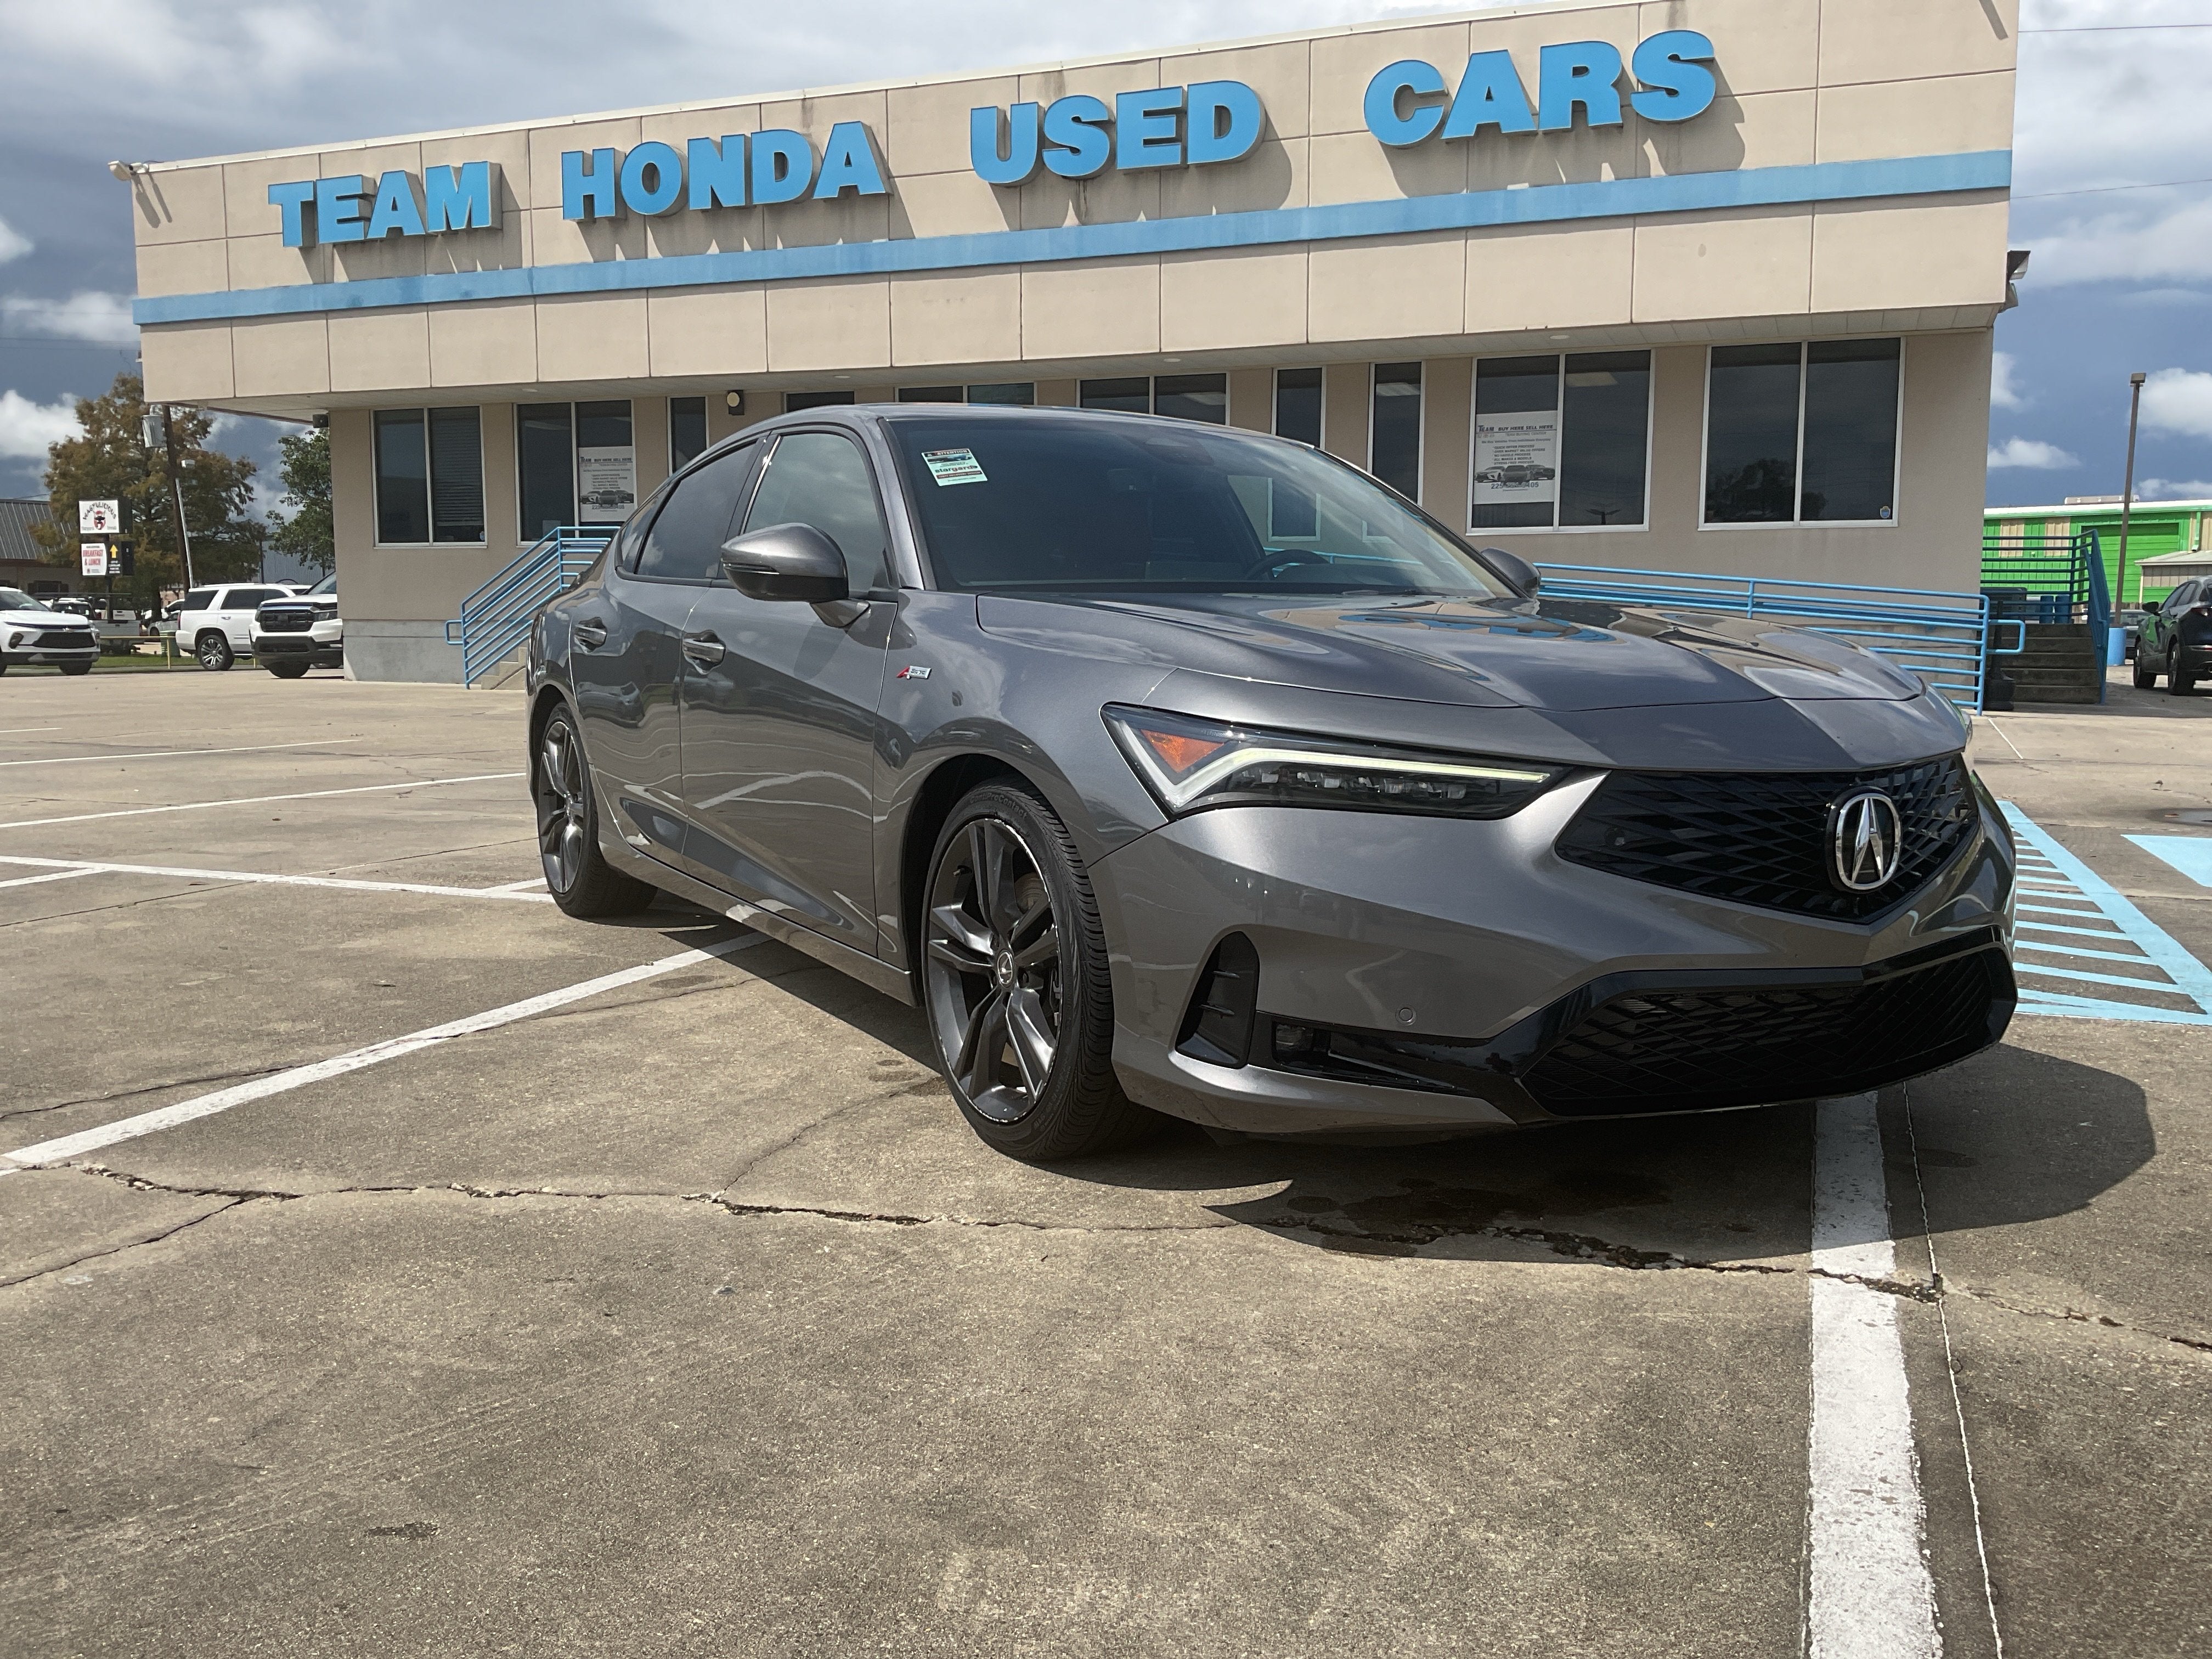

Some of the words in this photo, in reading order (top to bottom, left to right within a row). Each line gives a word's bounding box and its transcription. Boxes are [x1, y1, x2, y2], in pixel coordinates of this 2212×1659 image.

[268, 161, 499, 248] TEAM
[561, 121, 887, 222] HONDA
[970, 80, 1265, 187] USED
[1363, 30, 1717, 149] CARS
